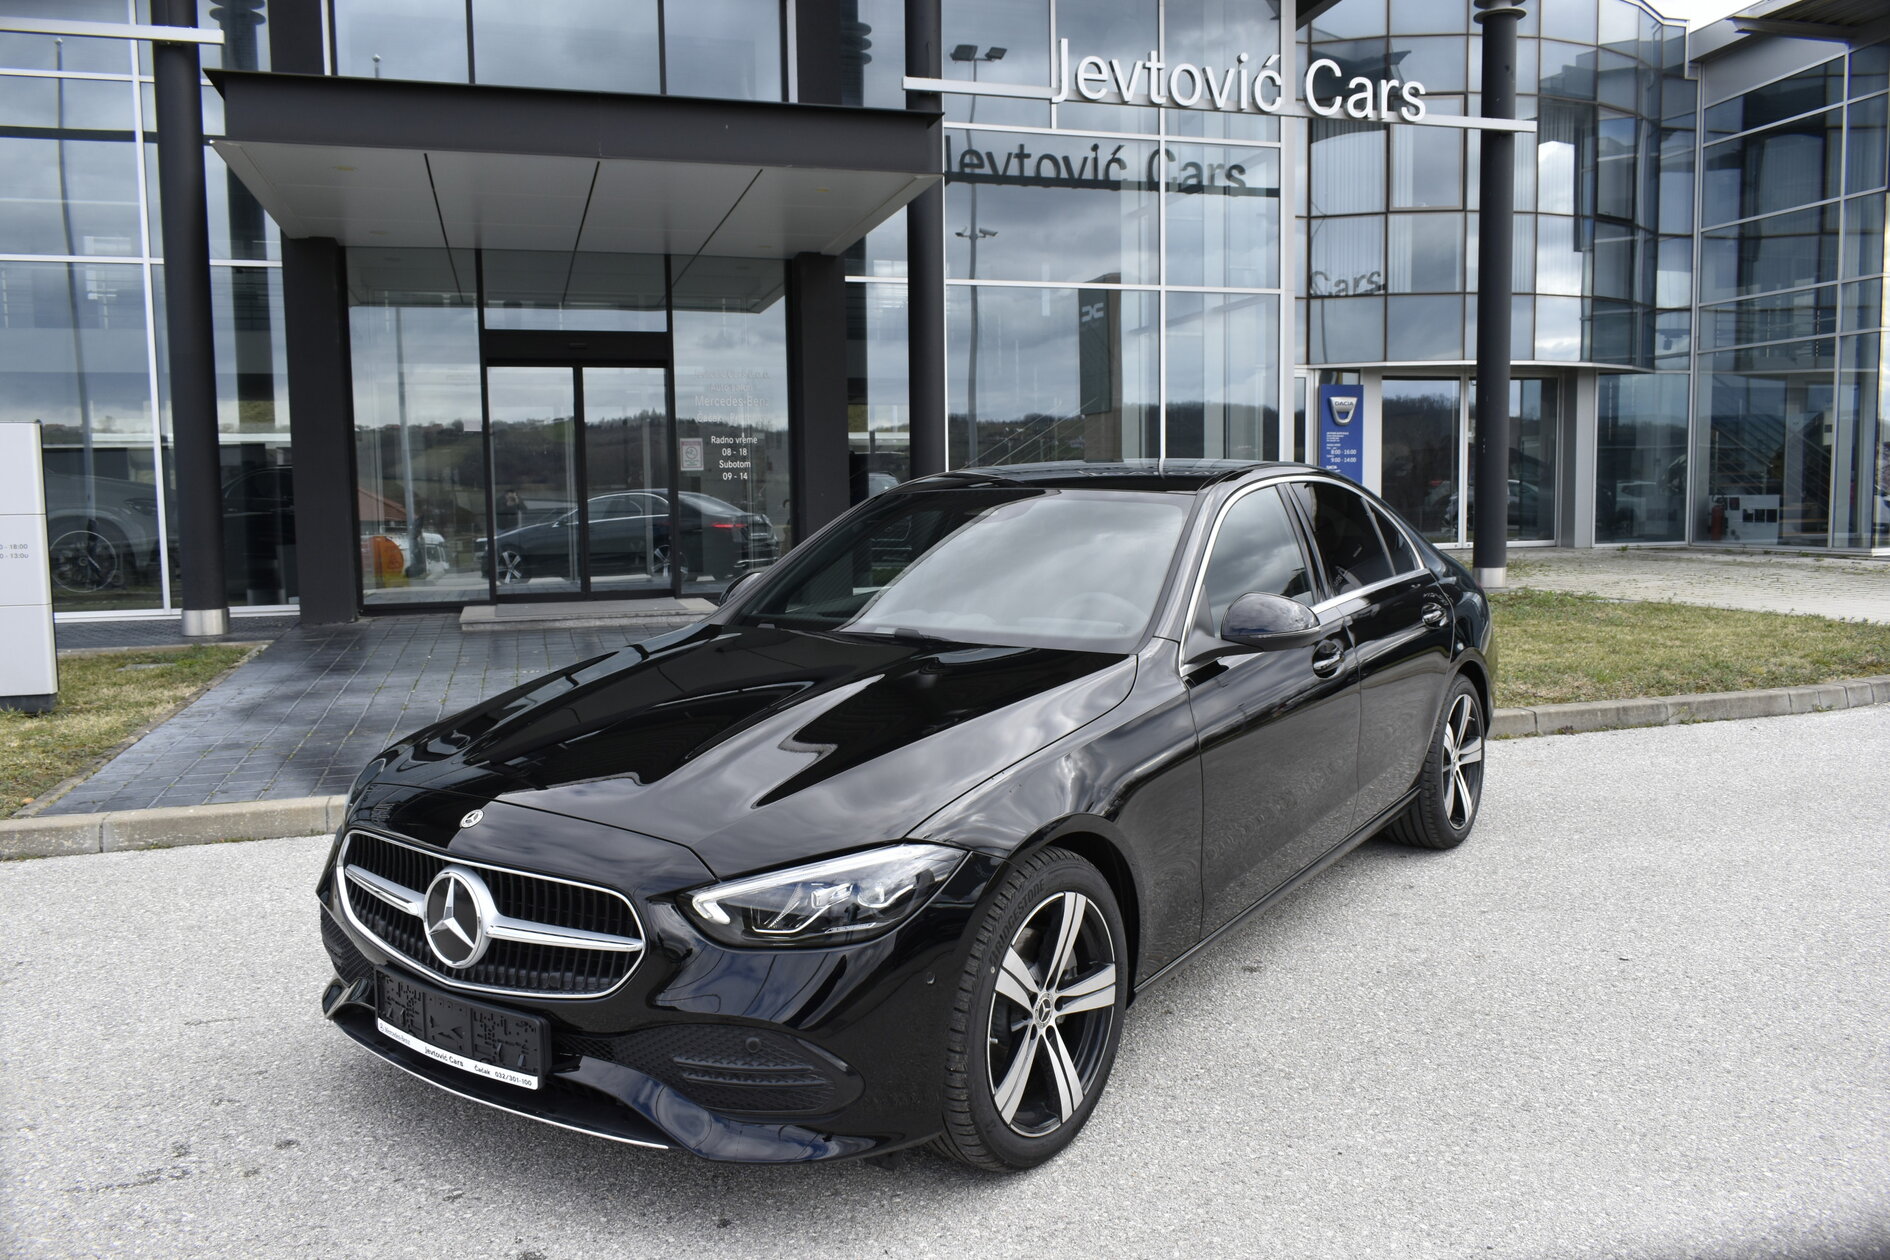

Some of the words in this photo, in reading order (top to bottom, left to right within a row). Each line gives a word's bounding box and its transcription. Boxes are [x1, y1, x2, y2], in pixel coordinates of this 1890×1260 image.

[1051, 38, 1282, 114] Jevtović
[1303, 58, 1427, 122] Cars
[711, 435, 734, 444] Radno
[736, 436, 758, 444] vreme
[722, 448, 732, 456] 08
[739, 448, 748, 456] 18
[719, 460, 751, 469] Subotom
[722, 472, 733, 480] 09
[740, 472, 748, 480] 14
[448, 1055, 464, 1067] Cars
[494, 1071, 533, 1087] 032/301-100
